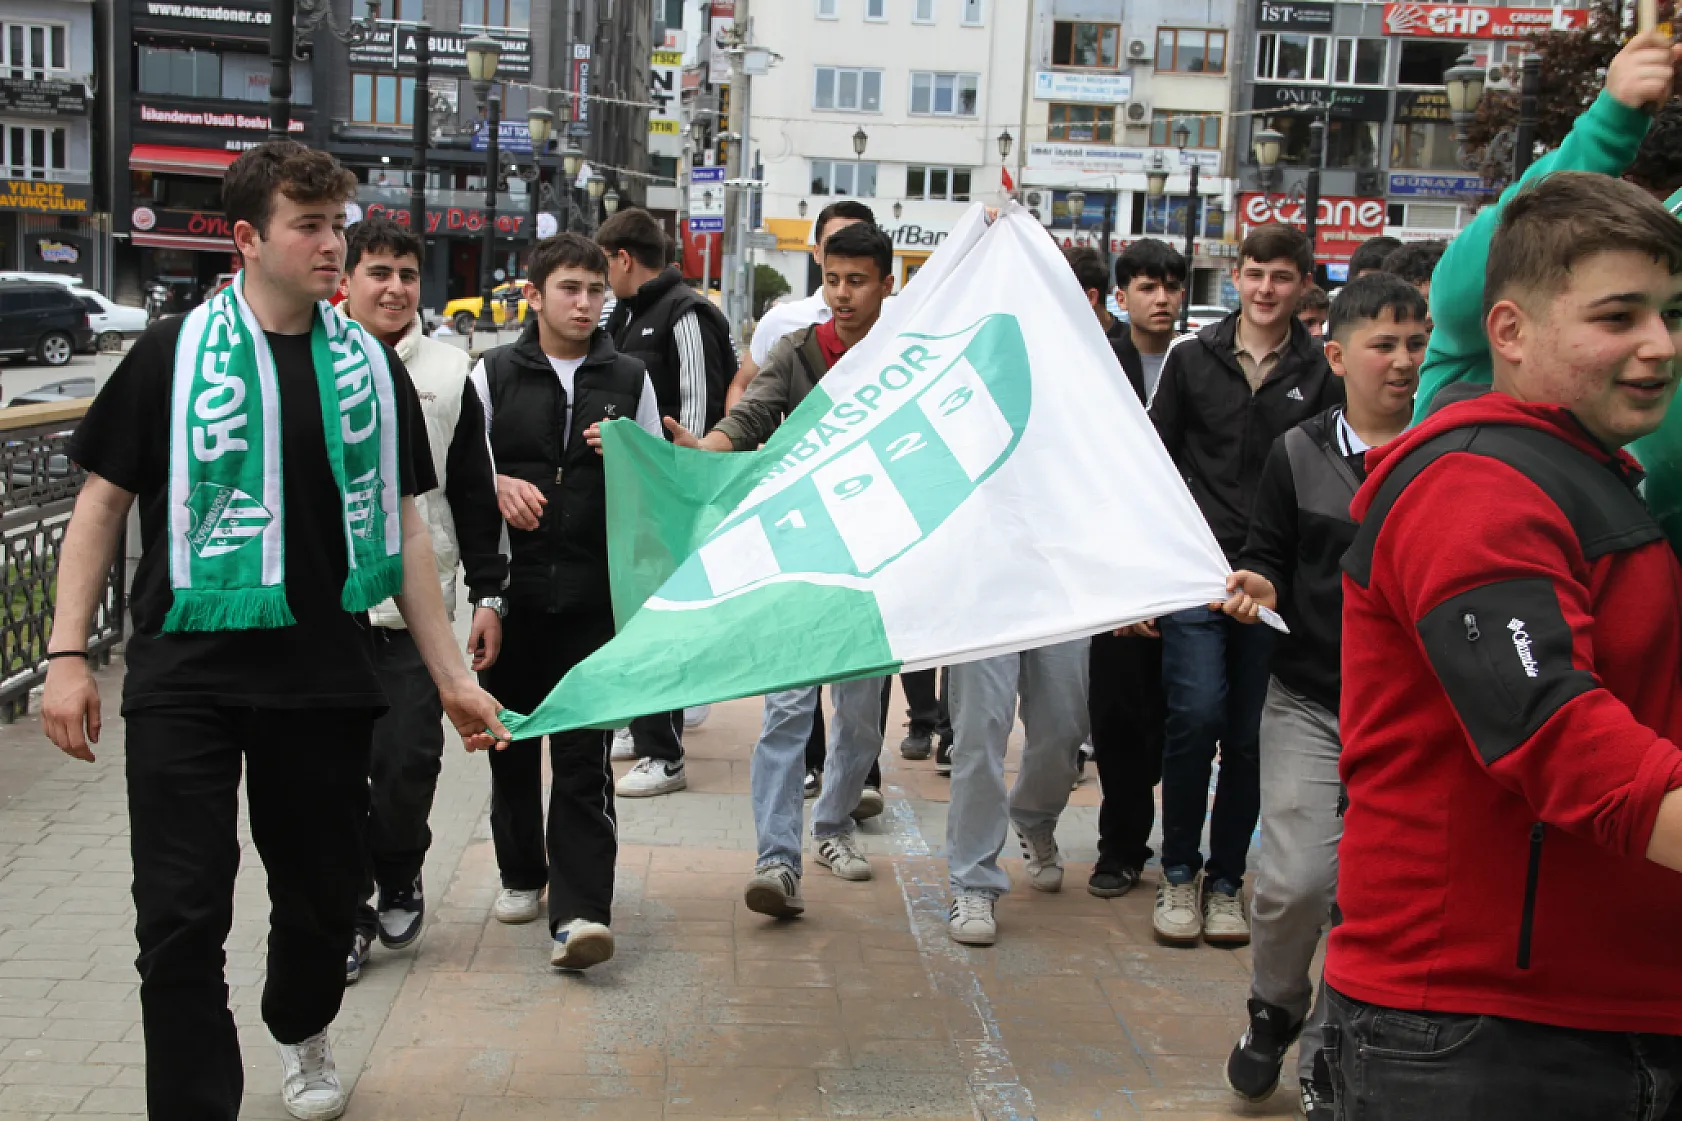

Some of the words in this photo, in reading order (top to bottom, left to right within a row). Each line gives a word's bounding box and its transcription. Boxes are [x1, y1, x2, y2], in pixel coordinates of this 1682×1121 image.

[147, 2, 297, 26] www.oncudoner.co
[1427, 8, 1490, 35] CHP
[8, 180, 65, 197] YILDIZ
[367, 203, 441, 233] Cray
[447, 207, 524, 233] Döer
